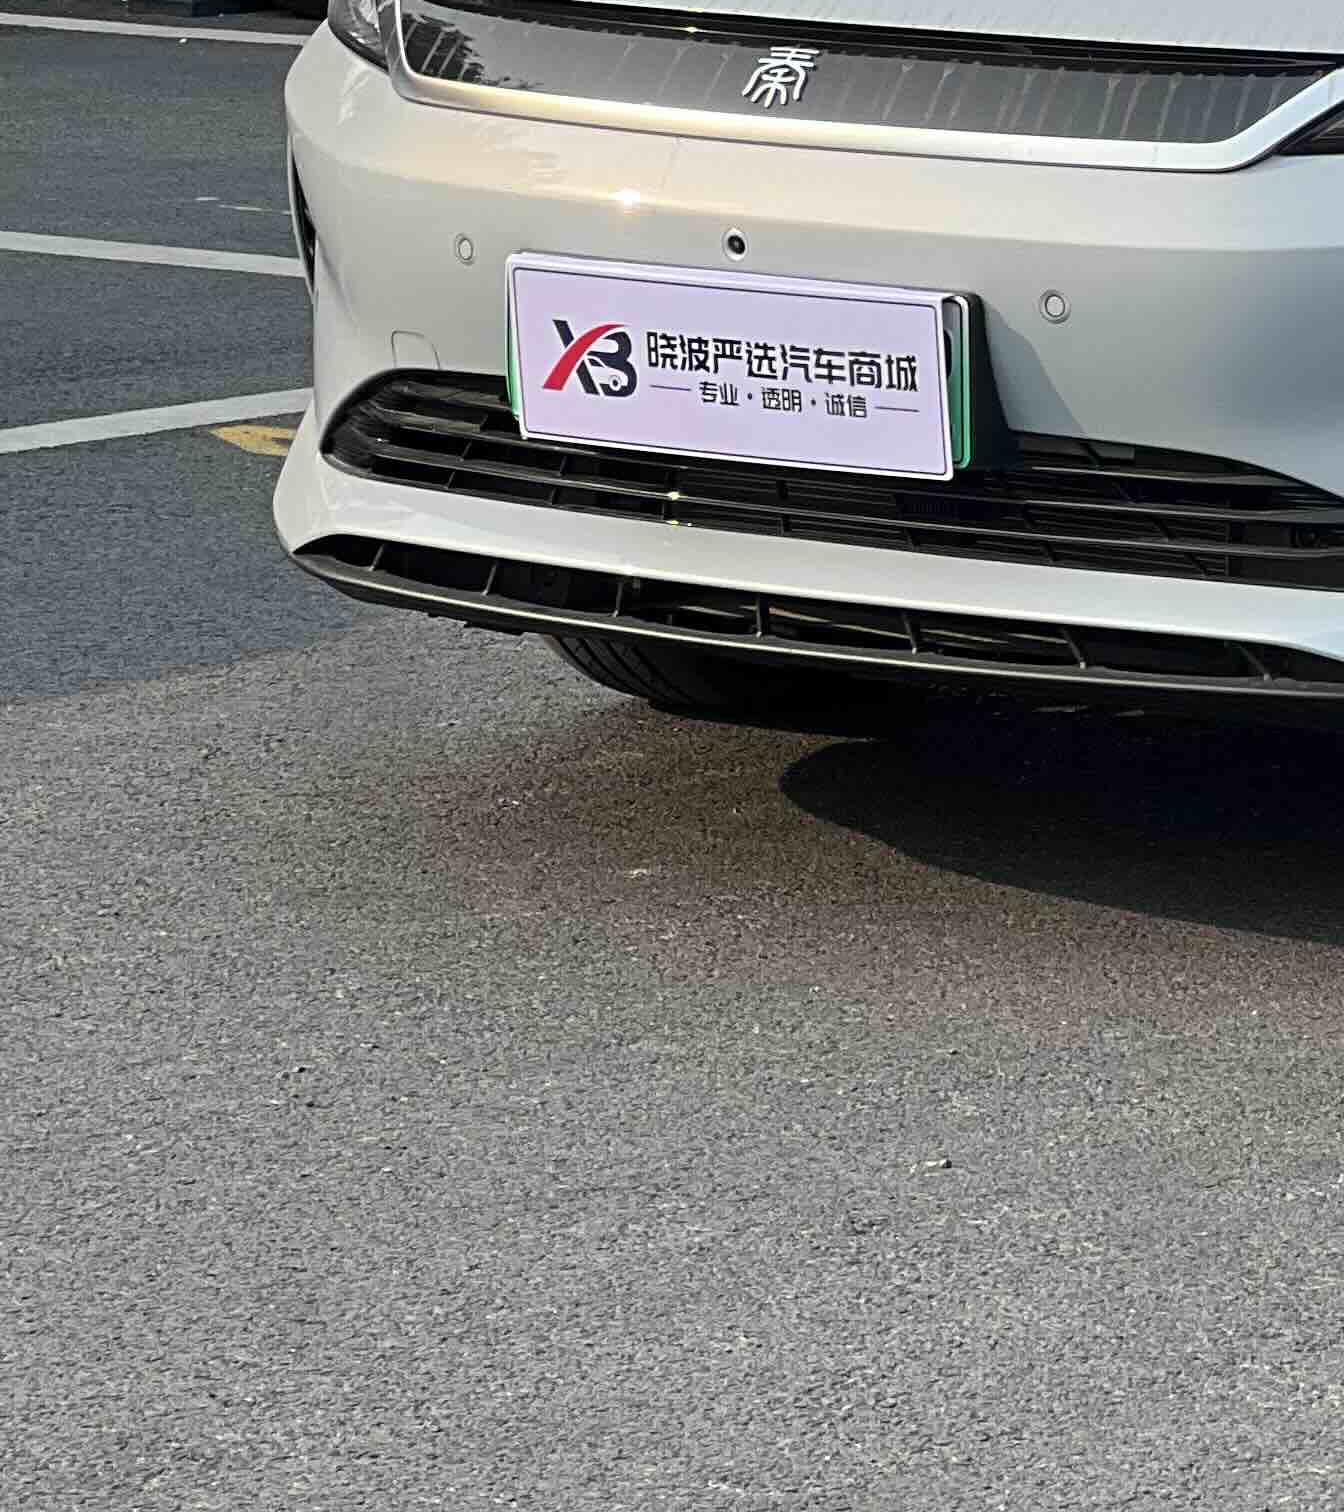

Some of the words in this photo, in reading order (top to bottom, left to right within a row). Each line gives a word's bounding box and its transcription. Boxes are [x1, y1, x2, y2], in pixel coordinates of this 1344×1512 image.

[646, 331, 919, 392] 晓波严选汽车商城
